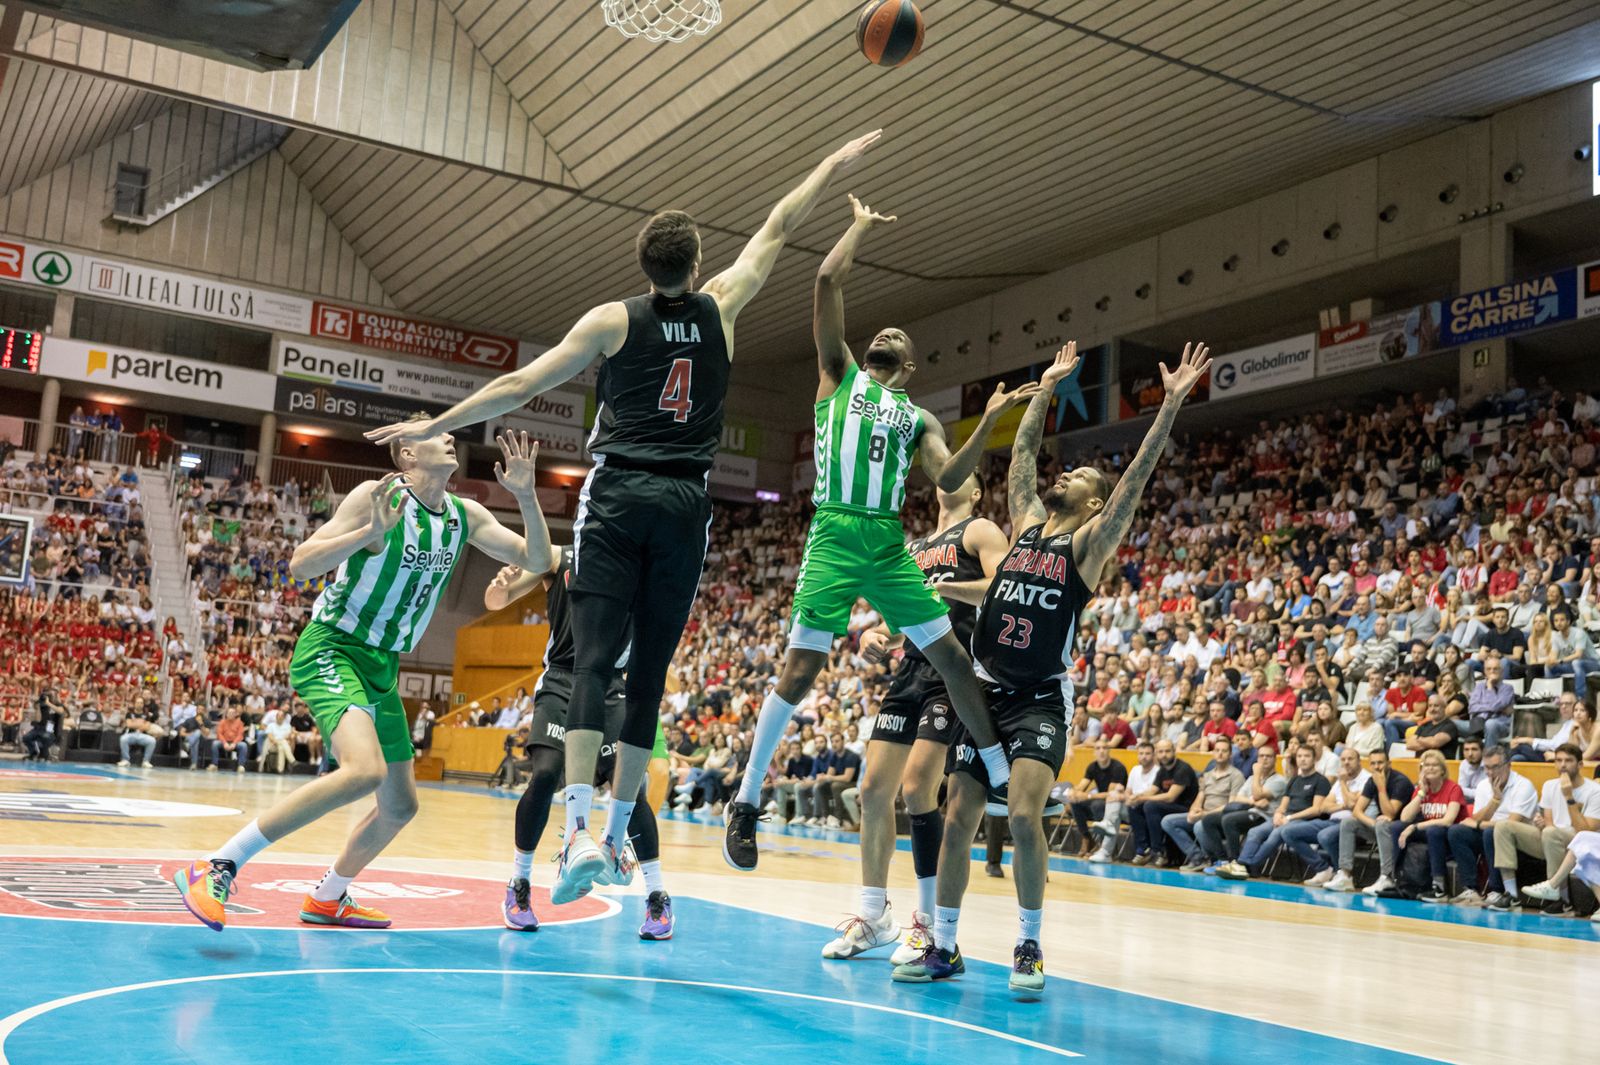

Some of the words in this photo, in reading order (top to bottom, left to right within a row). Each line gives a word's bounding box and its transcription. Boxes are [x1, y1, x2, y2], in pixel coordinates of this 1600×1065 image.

[124, 272, 183, 307] LLEAL
[193, 284, 254, 319] TULSÀ
[1450, 276, 1558, 316] CALSINA
[357, 312, 464, 342] EQUIPACIONS
[363, 325, 457, 352] ESPORTIVES
[661, 322, 701, 342] VILA
[111, 353, 223, 389] parlem
[283, 347, 384, 383] Panella
[1241, 348, 1311, 375] Globalimar
[396, 369, 474, 389] www.panella.cat
[658, 358, 693, 423] 4
[850, 392, 914, 434] Sevilla
[868, 434, 888, 463] 8
[994, 578, 1063, 611] FIATC
[997, 613, 1034, 649] 23
[876, 713, 907, 733] YOSOY
